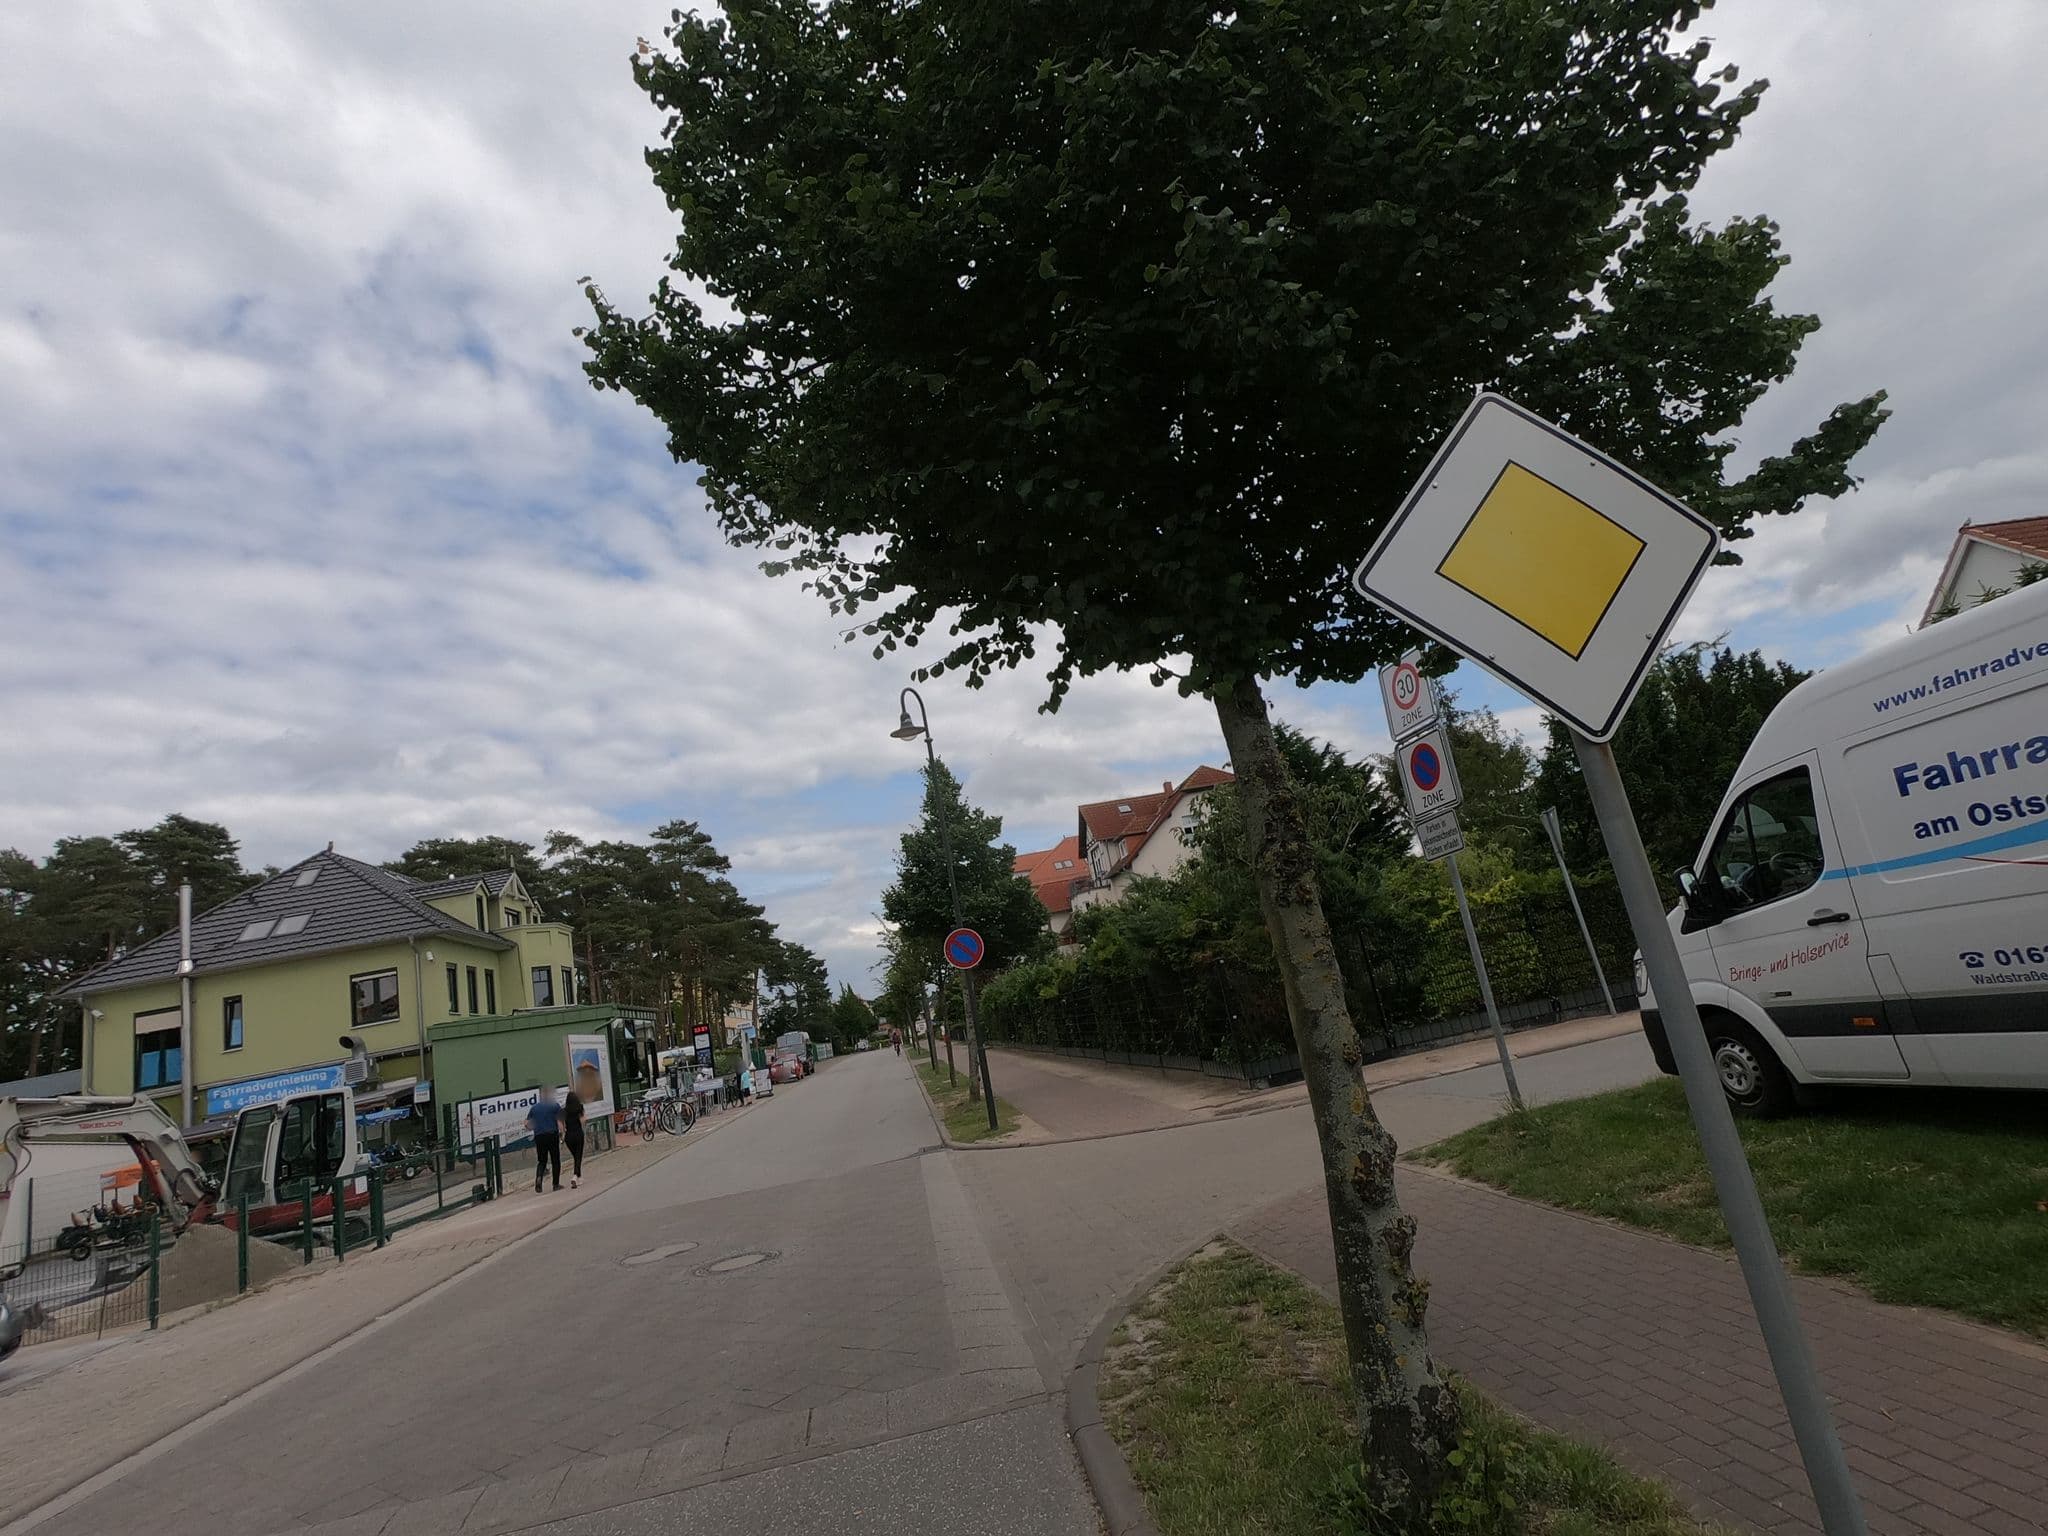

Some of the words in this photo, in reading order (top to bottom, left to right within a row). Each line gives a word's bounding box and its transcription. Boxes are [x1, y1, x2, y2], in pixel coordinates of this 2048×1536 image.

[1397, 673, 1414, 698] 30
[1401, 706, 1423, 727] ZONE
[1893, 736, 2048, 797] Fahrra
[1422, 789, 1445, 808] ZONE
[1913, 815, 1959, 839] am
[1967, 794, 2048, 826] Osts
[1729, 965, 1766, 982] Bringe-
[1770, 953, 1788, 974] und
[1791, 932, 1850, 967] Holservice
[1993, 945, 2048, 967] 016
[1970, 970, 2048, 985] Waldstraße
[213, 1071, 327, 1099] Fahrradvermietung
[223, 1100, 232, 1110] &
[479, 1094, 537, 1116] Fahrrad
